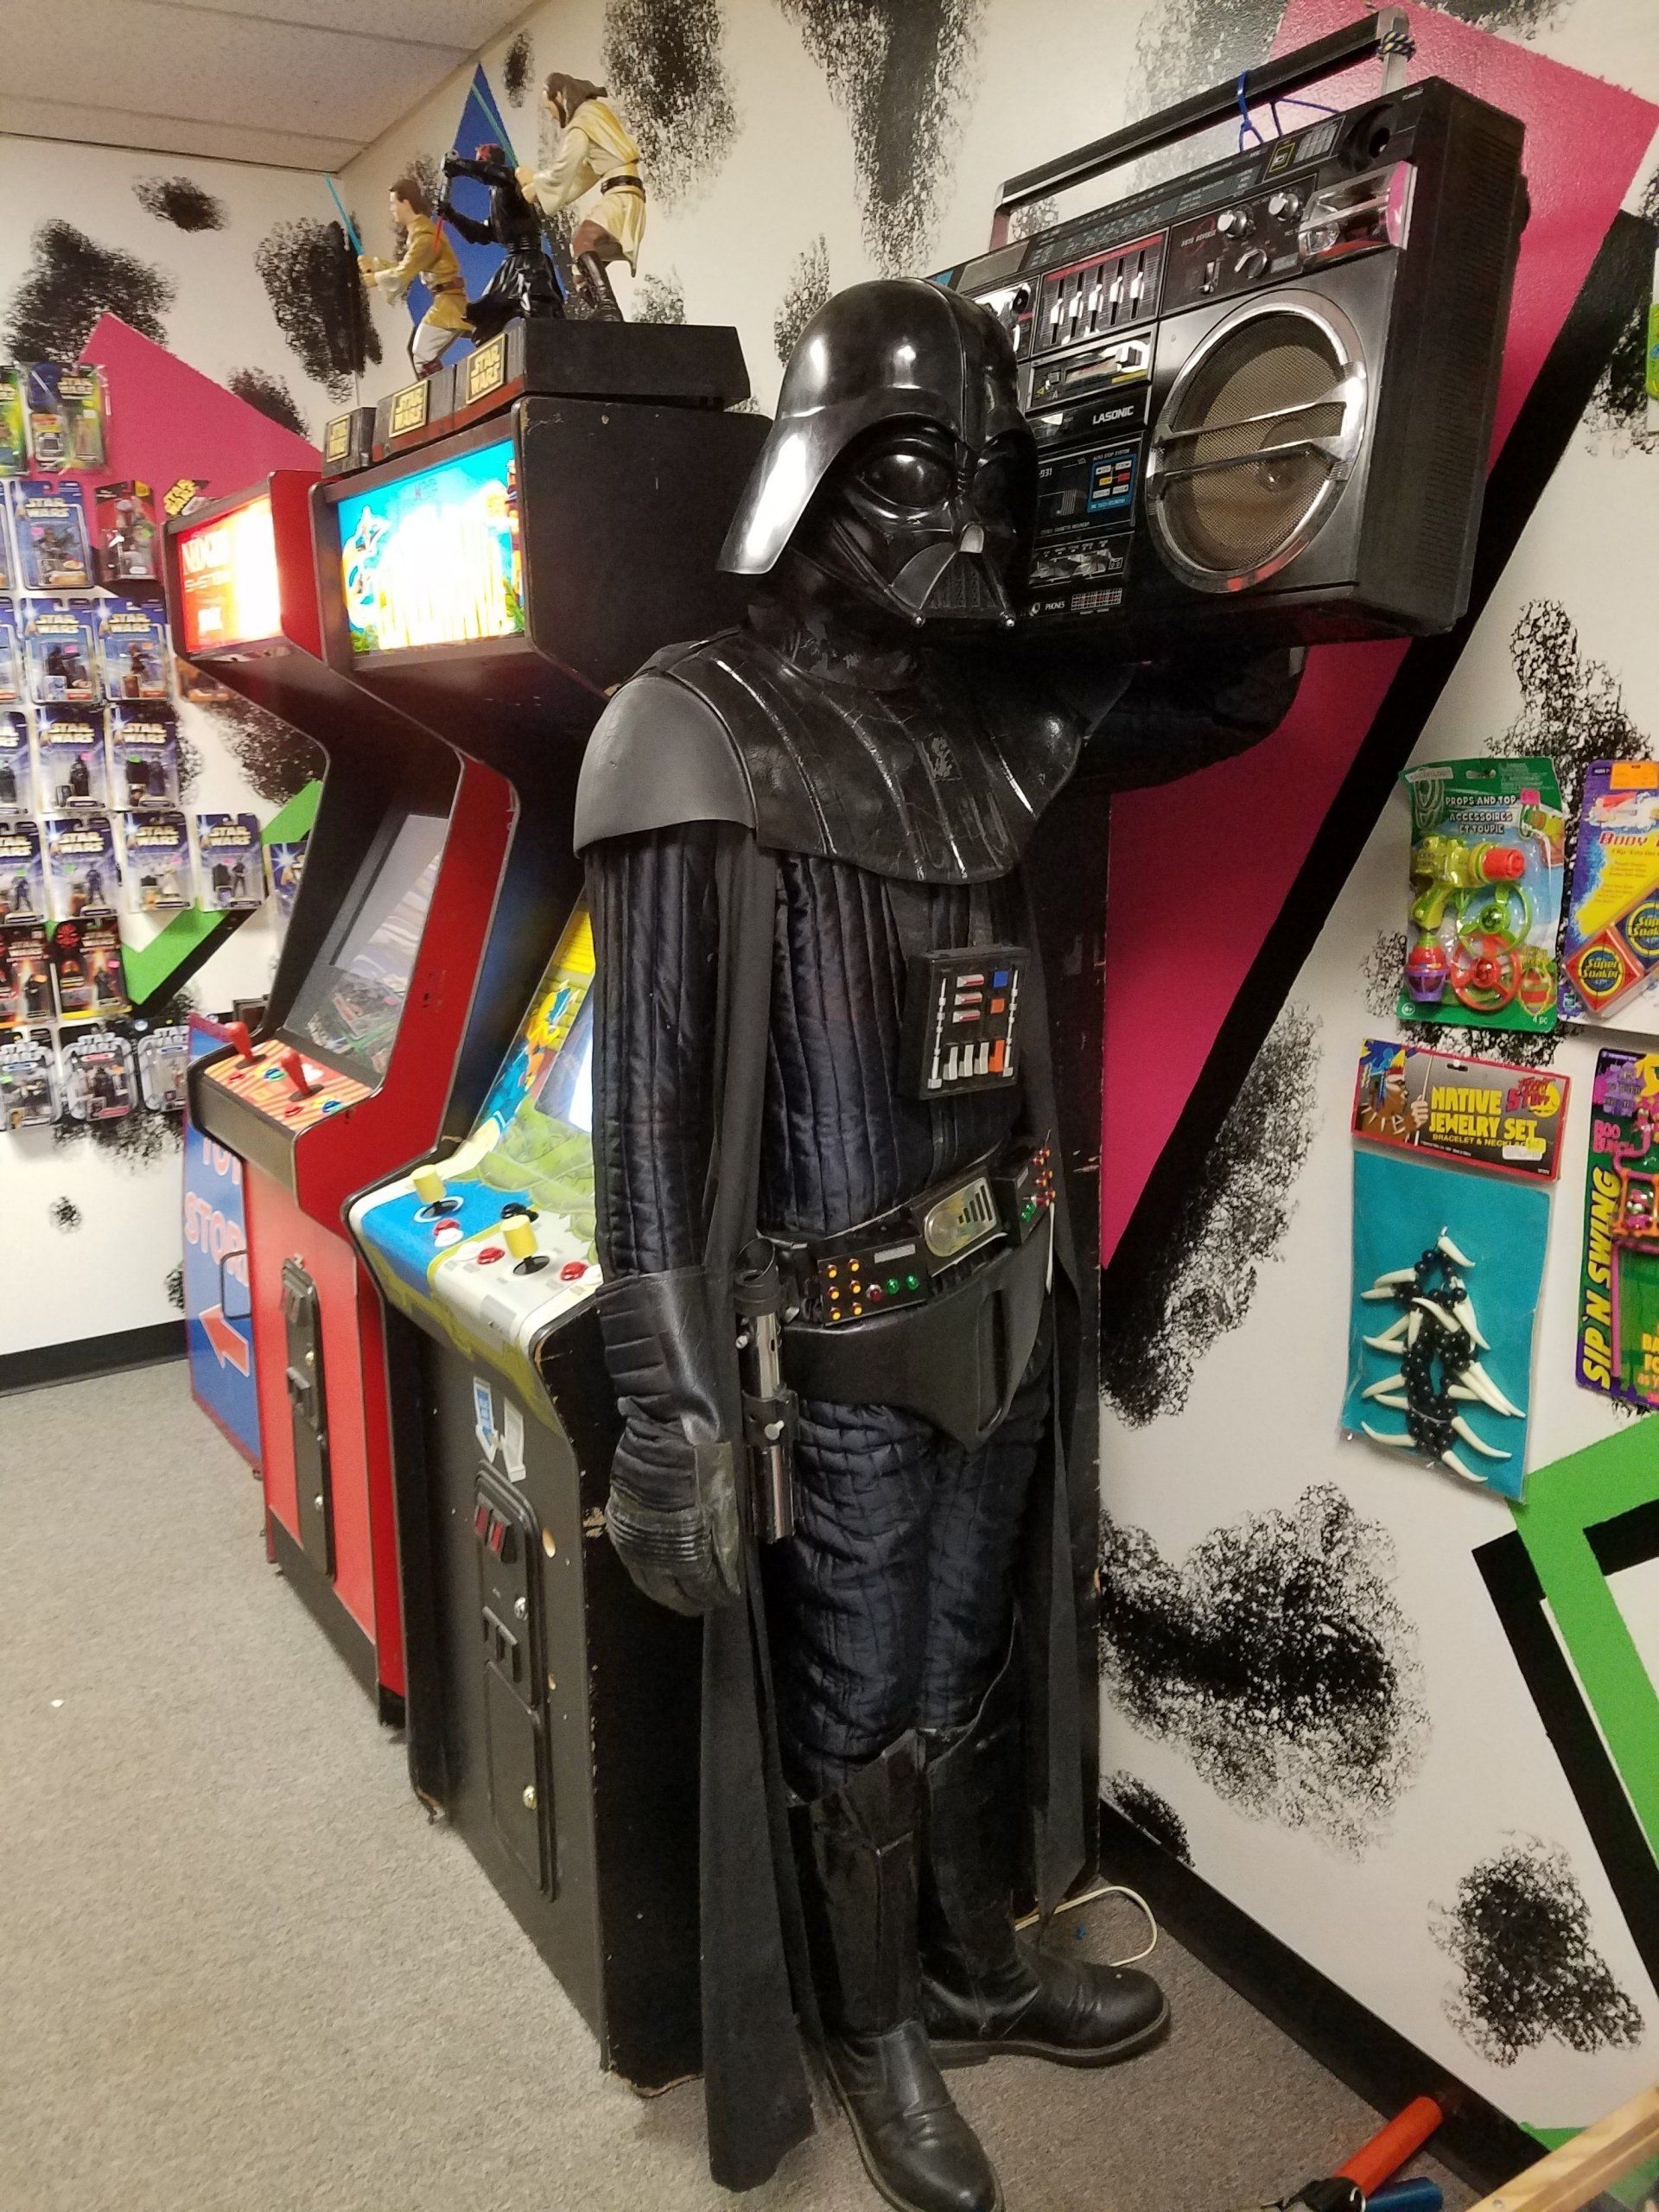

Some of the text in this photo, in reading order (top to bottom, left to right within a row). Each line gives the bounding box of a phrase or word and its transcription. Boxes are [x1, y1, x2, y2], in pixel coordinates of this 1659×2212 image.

[1092, 405, 1135, 425] LASONIC
[25, 498, 67, 507] STAR
[27, 507, 70, 518] WARS
[1046, 601, 1065, 611] PHONES
[35, 614, 79, 624] STAR
[109, 613, 151, 623] STAR
[37, 624, 79, 633] WARS
[111, 623, 151, 633] WARS
[48, 722, 94, 734] STAR
[123, 722, 167, 734] STAR
[49, 733, 94, 743] WARS
[124, 733, 167, 743] WARS
[1446, 796, 1516, 806] PROPS AND TOP
[1449, 812, 1512, 822] ACCESSOIRES
[136, 826, 179, 836] STAR
[208, 826, 251, 836] STAR
[1459, 824, 1504, 834] ET TOUPIE
[59, 832, 104, 843] STAR
[137, 835, 179, 846] WARS
[209, 836, 251, 846] WARS
[60, 842, 104, 854] WARS
[1637, 917, 1659, 928] Sup
[1587, 958, 1618, 969] Super
[1583, 968, 1618, 978] Soaker
[1431, 1085, 1502, 1115] NATIVE
[1429, 1112, 1538, 1141] JEWELRY SET
[1594, 1119, 1621, 1139] BOO
[1433, 1134, 1474, 1145] BRACELET
[1484, 1139, 1529, 1148] NECKLAC
[1587, 1166, 1621, 1289] SWING
[1582, 1326, 1611, 1390] SIP
